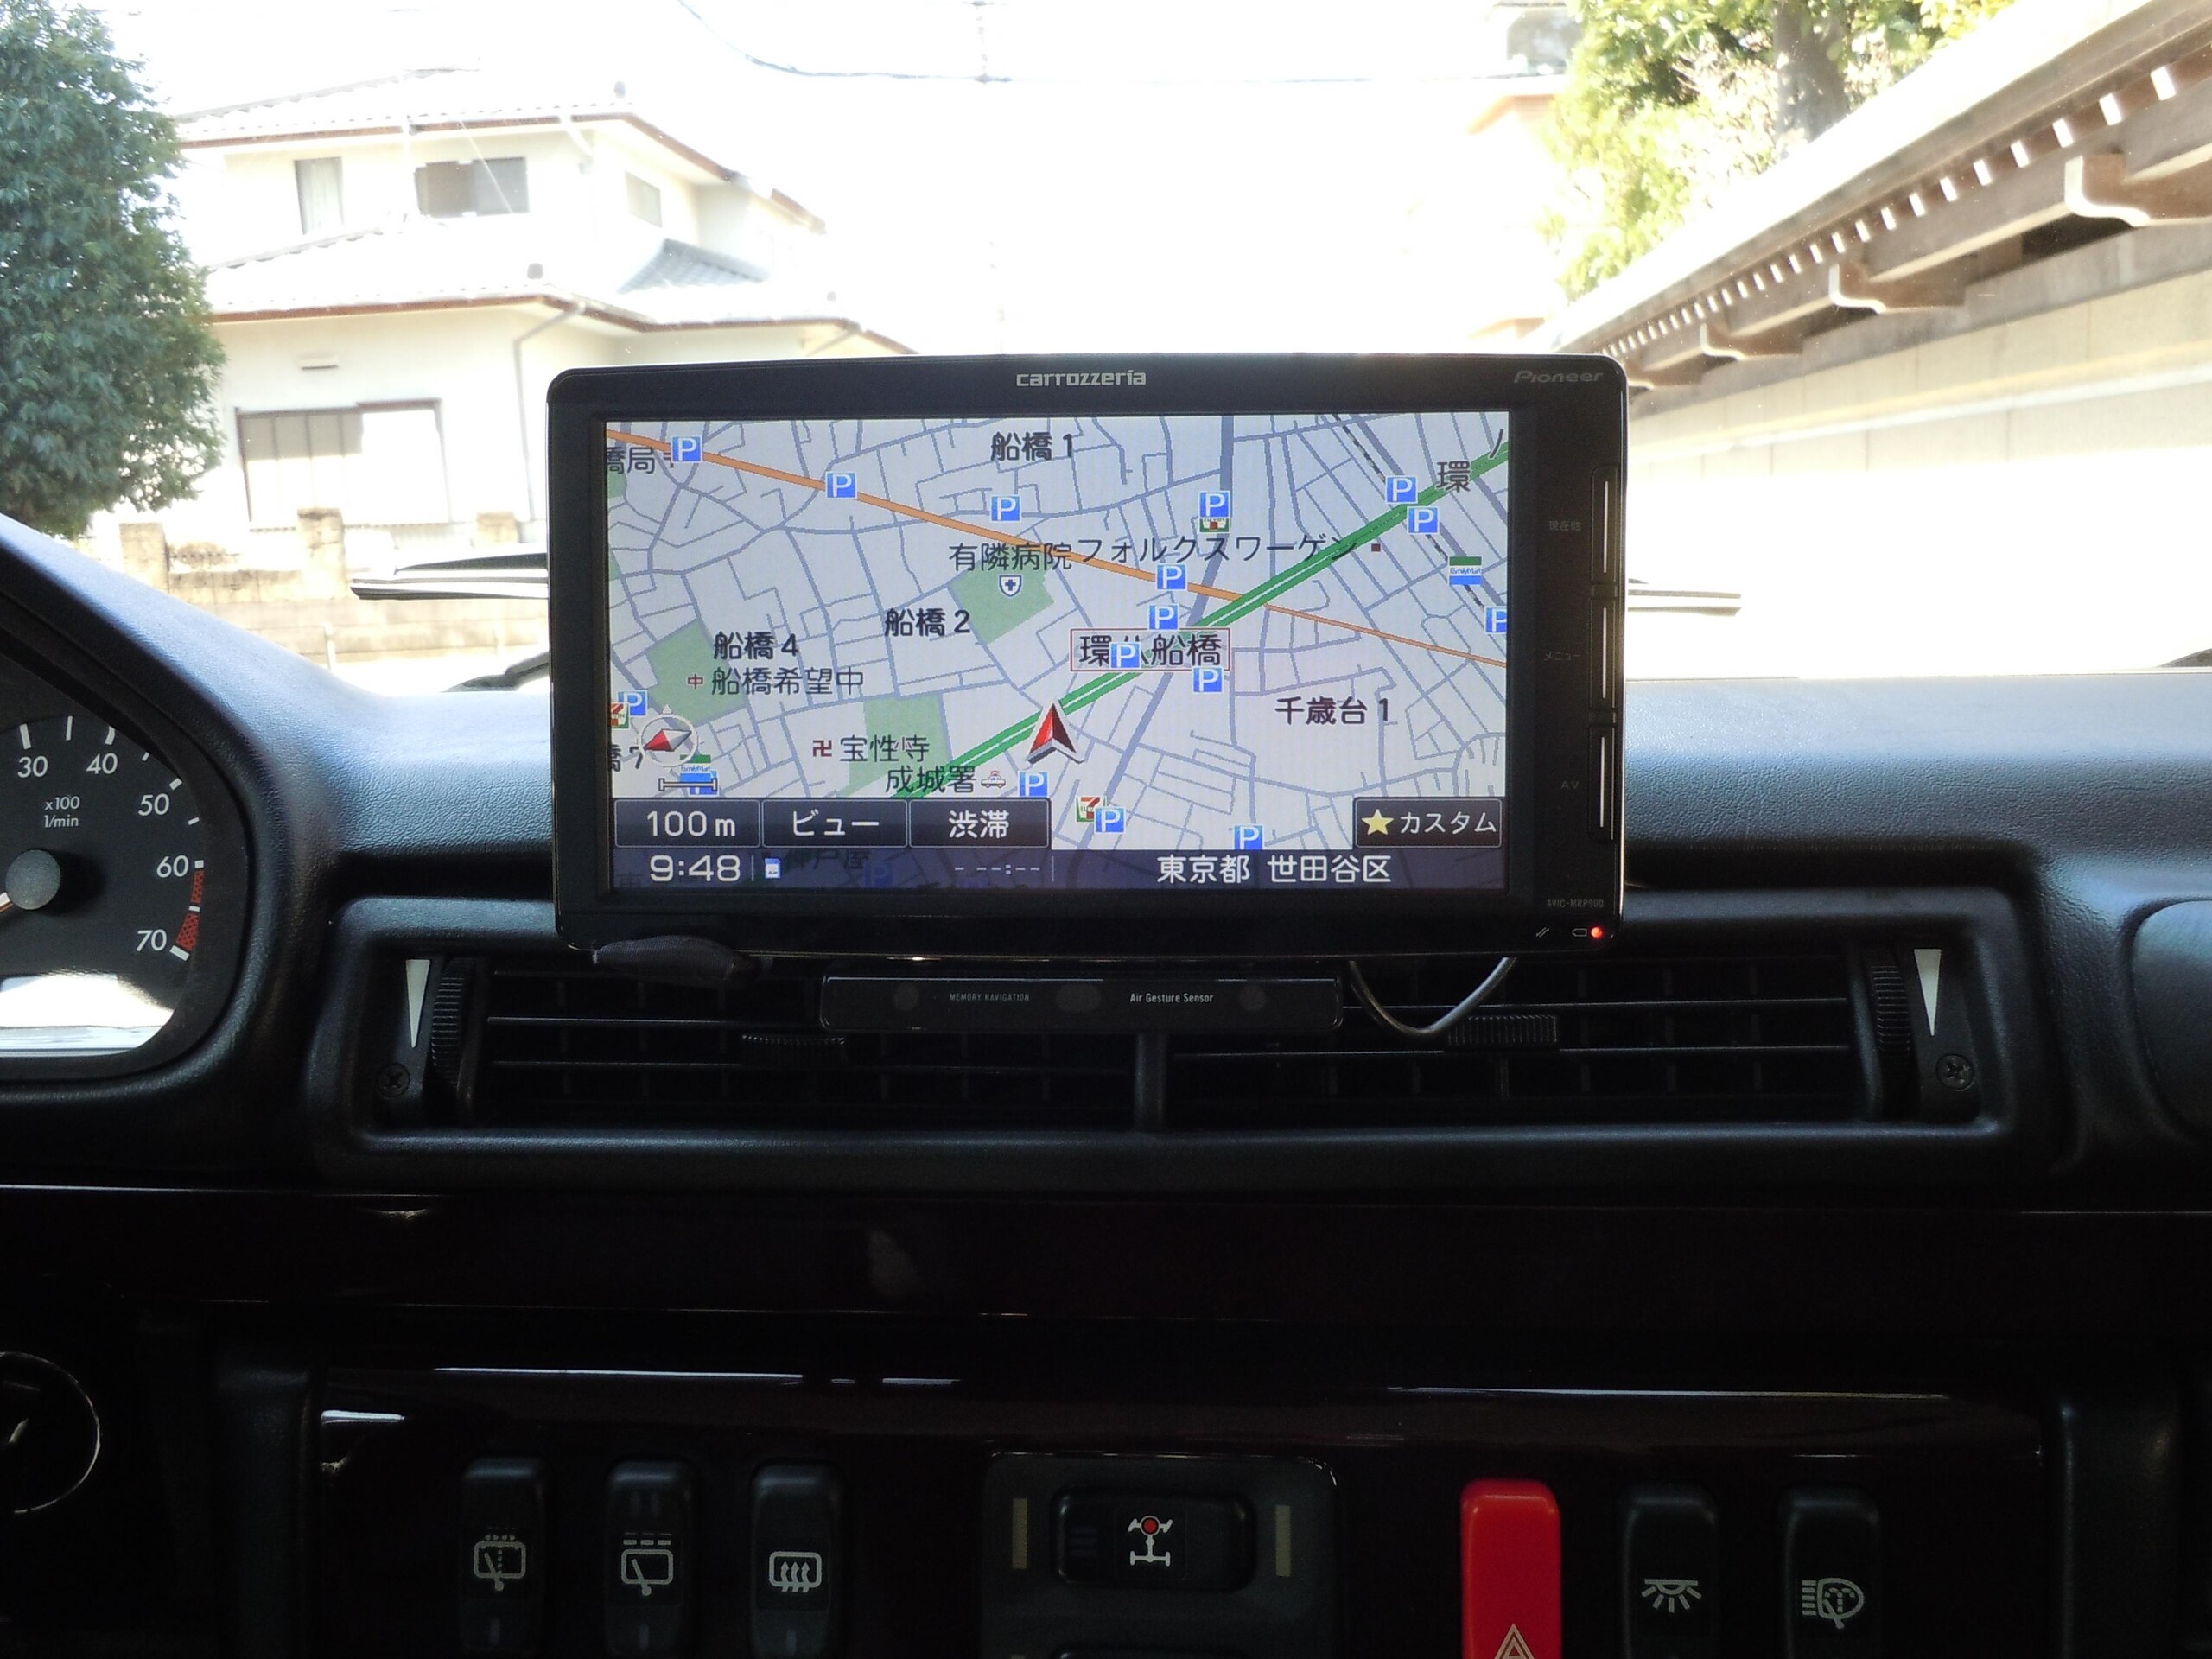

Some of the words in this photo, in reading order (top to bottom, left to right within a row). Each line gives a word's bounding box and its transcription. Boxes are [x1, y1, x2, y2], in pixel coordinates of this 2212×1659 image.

[1016, 370, 1147, 386] carrozzeria
[1514, 370, 1604, 383] Pioneer
[949, 543, 1073, 571] 有隣病院
[1077, 533, 1357, 563] フォルクスワーゲン
[1543, 652, 1583, 662] メニュー
[712, 667, 864, 696] 船橋希望中
[840, 734, 930, 762] 宝性寺
[17, 755, 48, 778] 30
[86, 753, 118, 775] 40
[886, 766, 977, 793] 成城署
[45, 796, 80, 811] x100
[137, 793, 170, 816] 50
[44, 815, 79, 829] 1/min
[792, 809, 880, 836] ビュー
[949, 810, 1010, 838] 渋滞
[1400, 811, 1497, 835] カスタム
[156, 855, 189, 878] 60
[650, 855, 741, 882] 9:48
[1157, 855, 1250, 884] 東京都
[1268, 855, 1392, 884] 世田谷区
[137, 929, 167, 951] 70
[950, 993, 982, 1001] MEMORY
[984, 993, 1029, 1001] NAVIGATION
[1130, 993, 1141, 1002] Air
[1145, 993, 1180, 1003] Gesture
[1183, 993, 1213, 1003] Sensor
